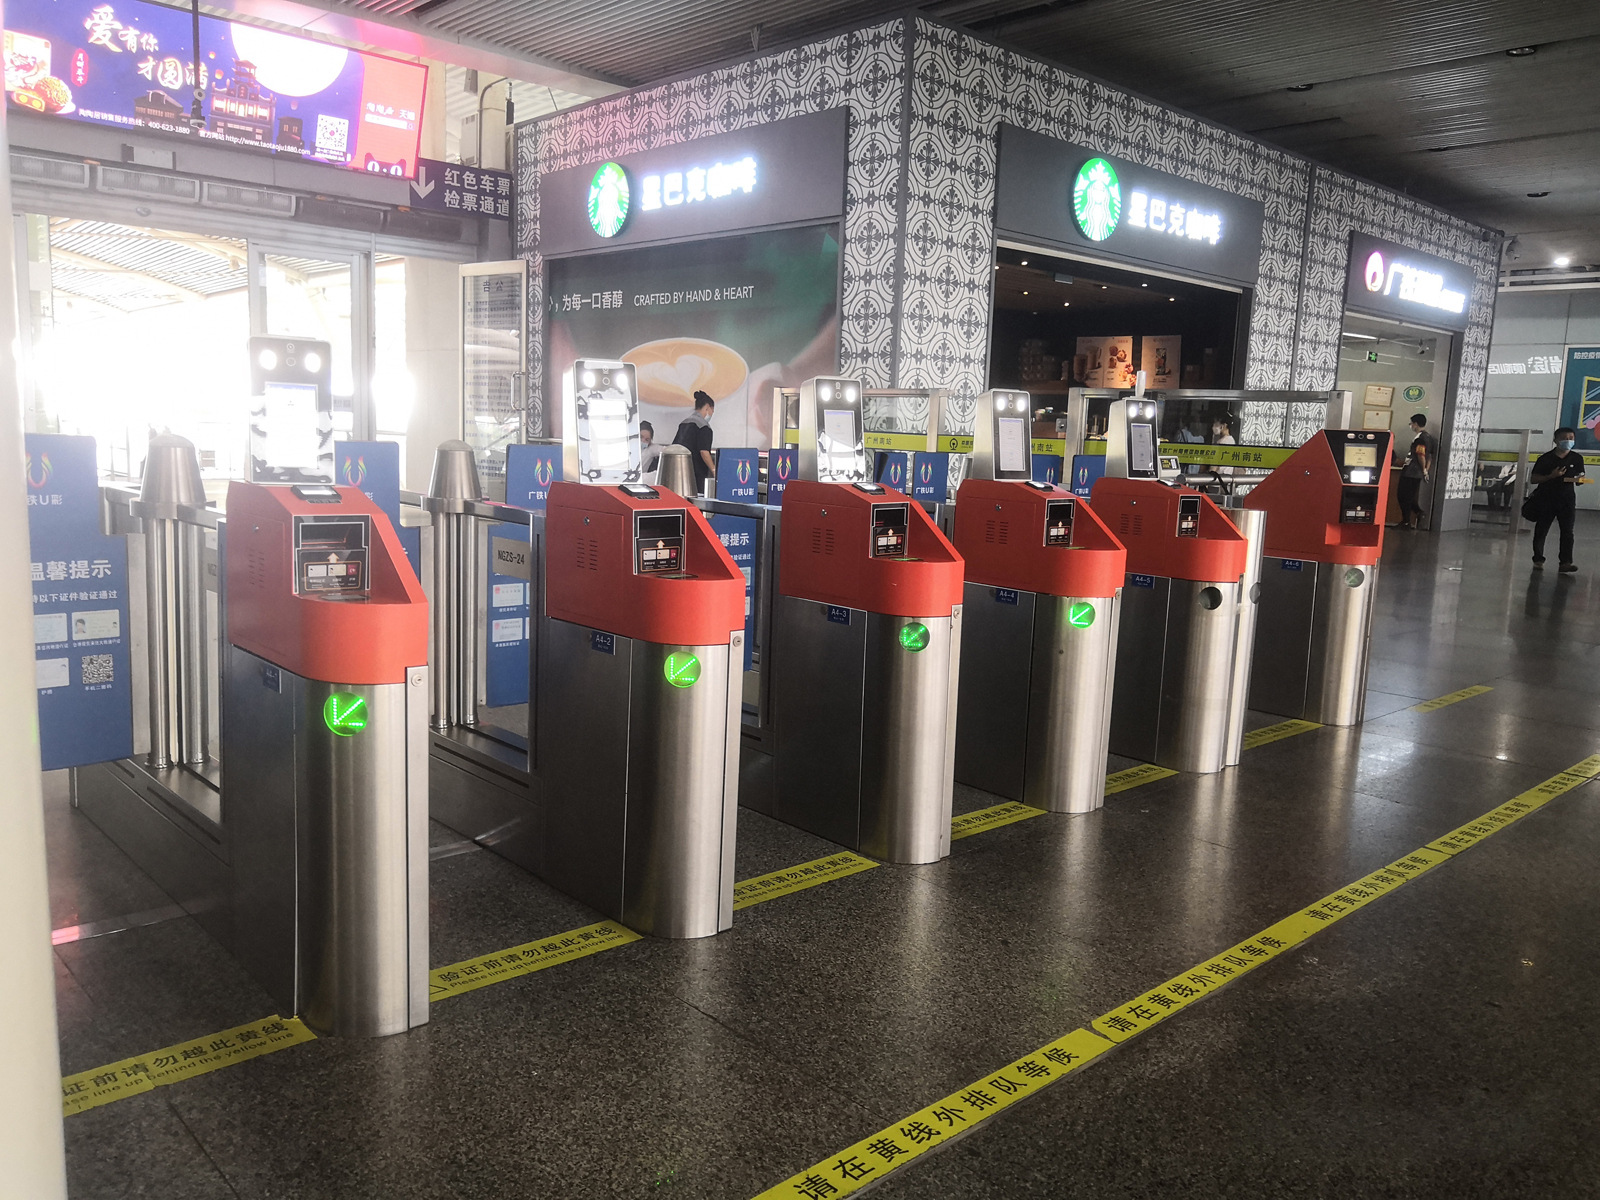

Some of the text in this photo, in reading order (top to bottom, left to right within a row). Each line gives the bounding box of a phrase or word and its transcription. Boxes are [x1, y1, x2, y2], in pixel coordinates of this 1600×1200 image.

[84, 4, 159, 53] 爱有你
[137, 55, 209, 90] 才圆满
[148, 121, 190, 134] 400-623-1880
[444, 167, 511, 196] 红色车票
[444, 189, 510, 217] 检票通道
[641, 156, 757, 212] 星巴克咖啡
[1127, 191, 1222, 246] 星巴克咖啡
[633, 285, 755, 307] CRAFTED BY HAND & HEART
[866, 437, 892, 446] 广州南站
[1220, 450, 1263, 463] 广州南站
[497, 549, 526, 566] NGZS-24
[1304, 855, 1433, 921] 请在黄线外排队等候
[437, 926, 617, 984] 验证前请勿越此黄线
[450, 933, 624, 988] Please line up behind the yellow line
[1102, 935, 1288, 1033] 请在黄线外排队等候
[93, 1085, 121, 1097] line
[125, 1078, 144, 1088] up
[198, 1053, 222, 1065] the
[224, 1039, 268, 1061] yellow
[269, 1031, 294, 1044] line
[793, 1047, 1080, 1200] 请在黄线外排队等候
